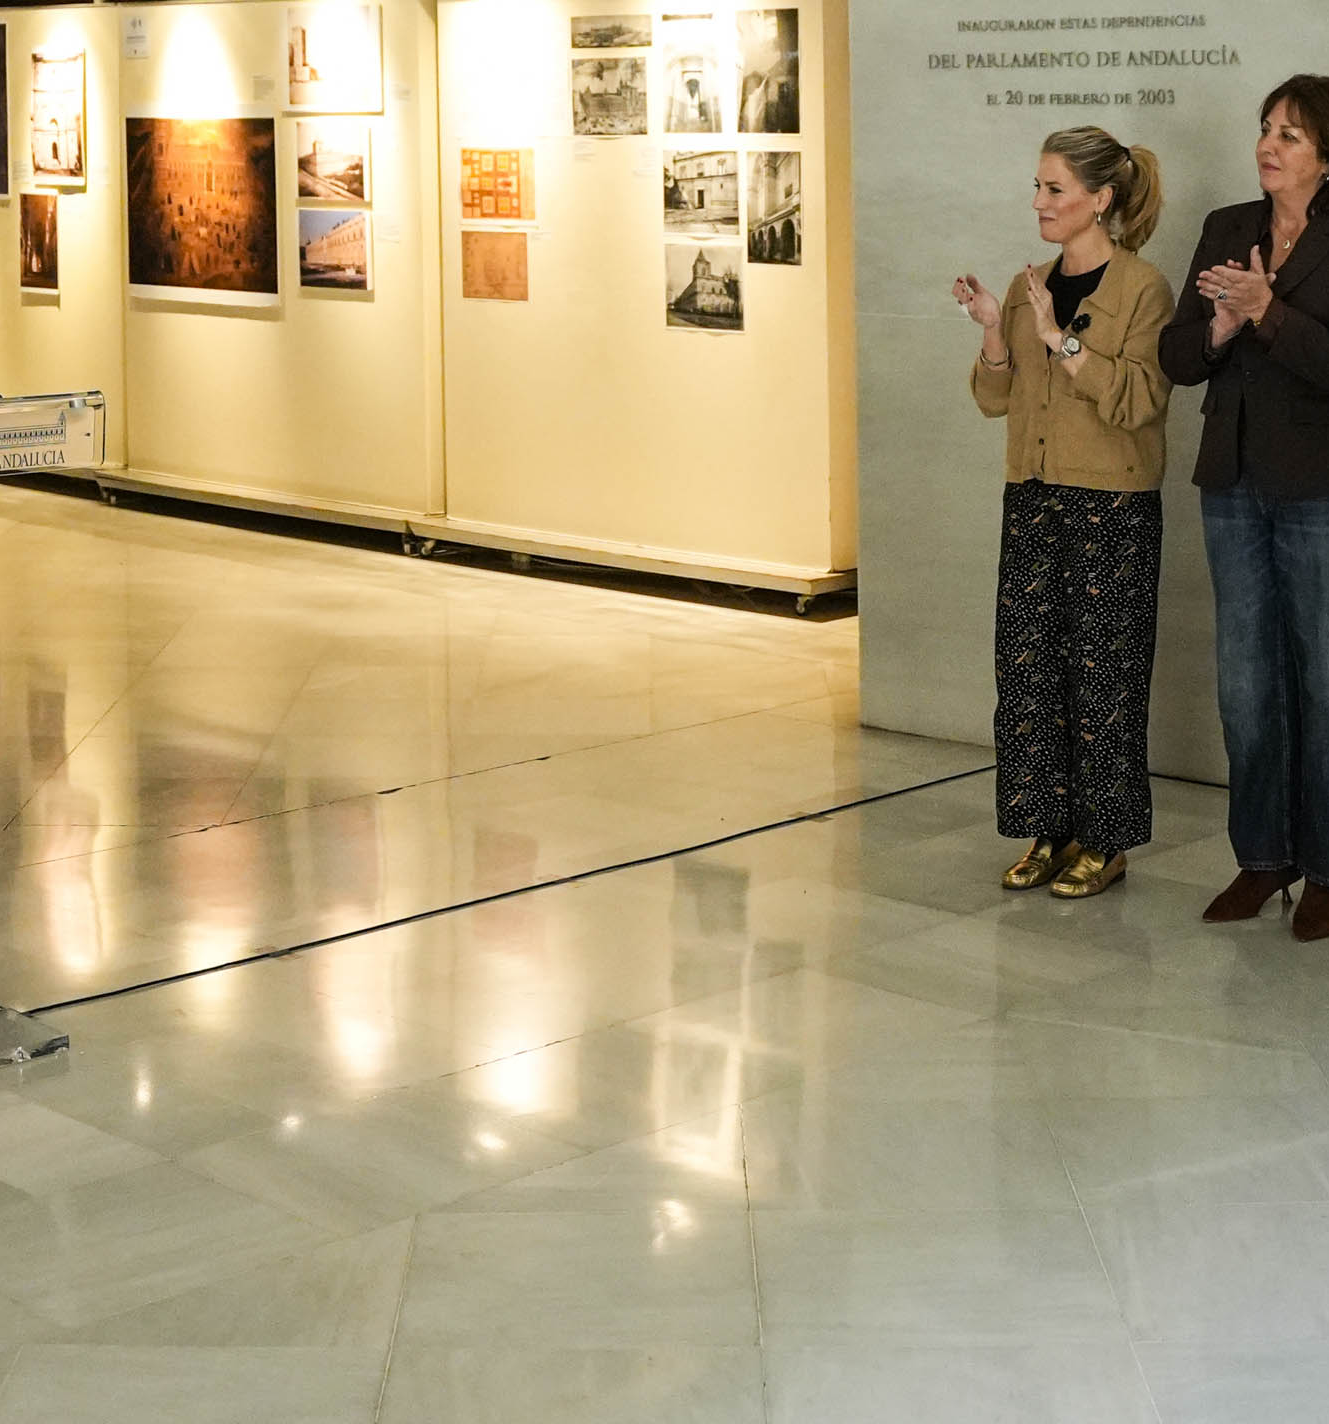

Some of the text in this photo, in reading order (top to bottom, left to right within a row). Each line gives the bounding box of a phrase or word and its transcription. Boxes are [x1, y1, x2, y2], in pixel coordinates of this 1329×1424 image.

[957, 14, 1206, 32] INAUGURARON ESTAS DEPENDENCIAS
[928, 44, 1241, 69] DEL PARLAMENTO DE ANDALUCÍA
[987, 89, 1175, 106] EL 20 DE FEBRERO DE 2003
